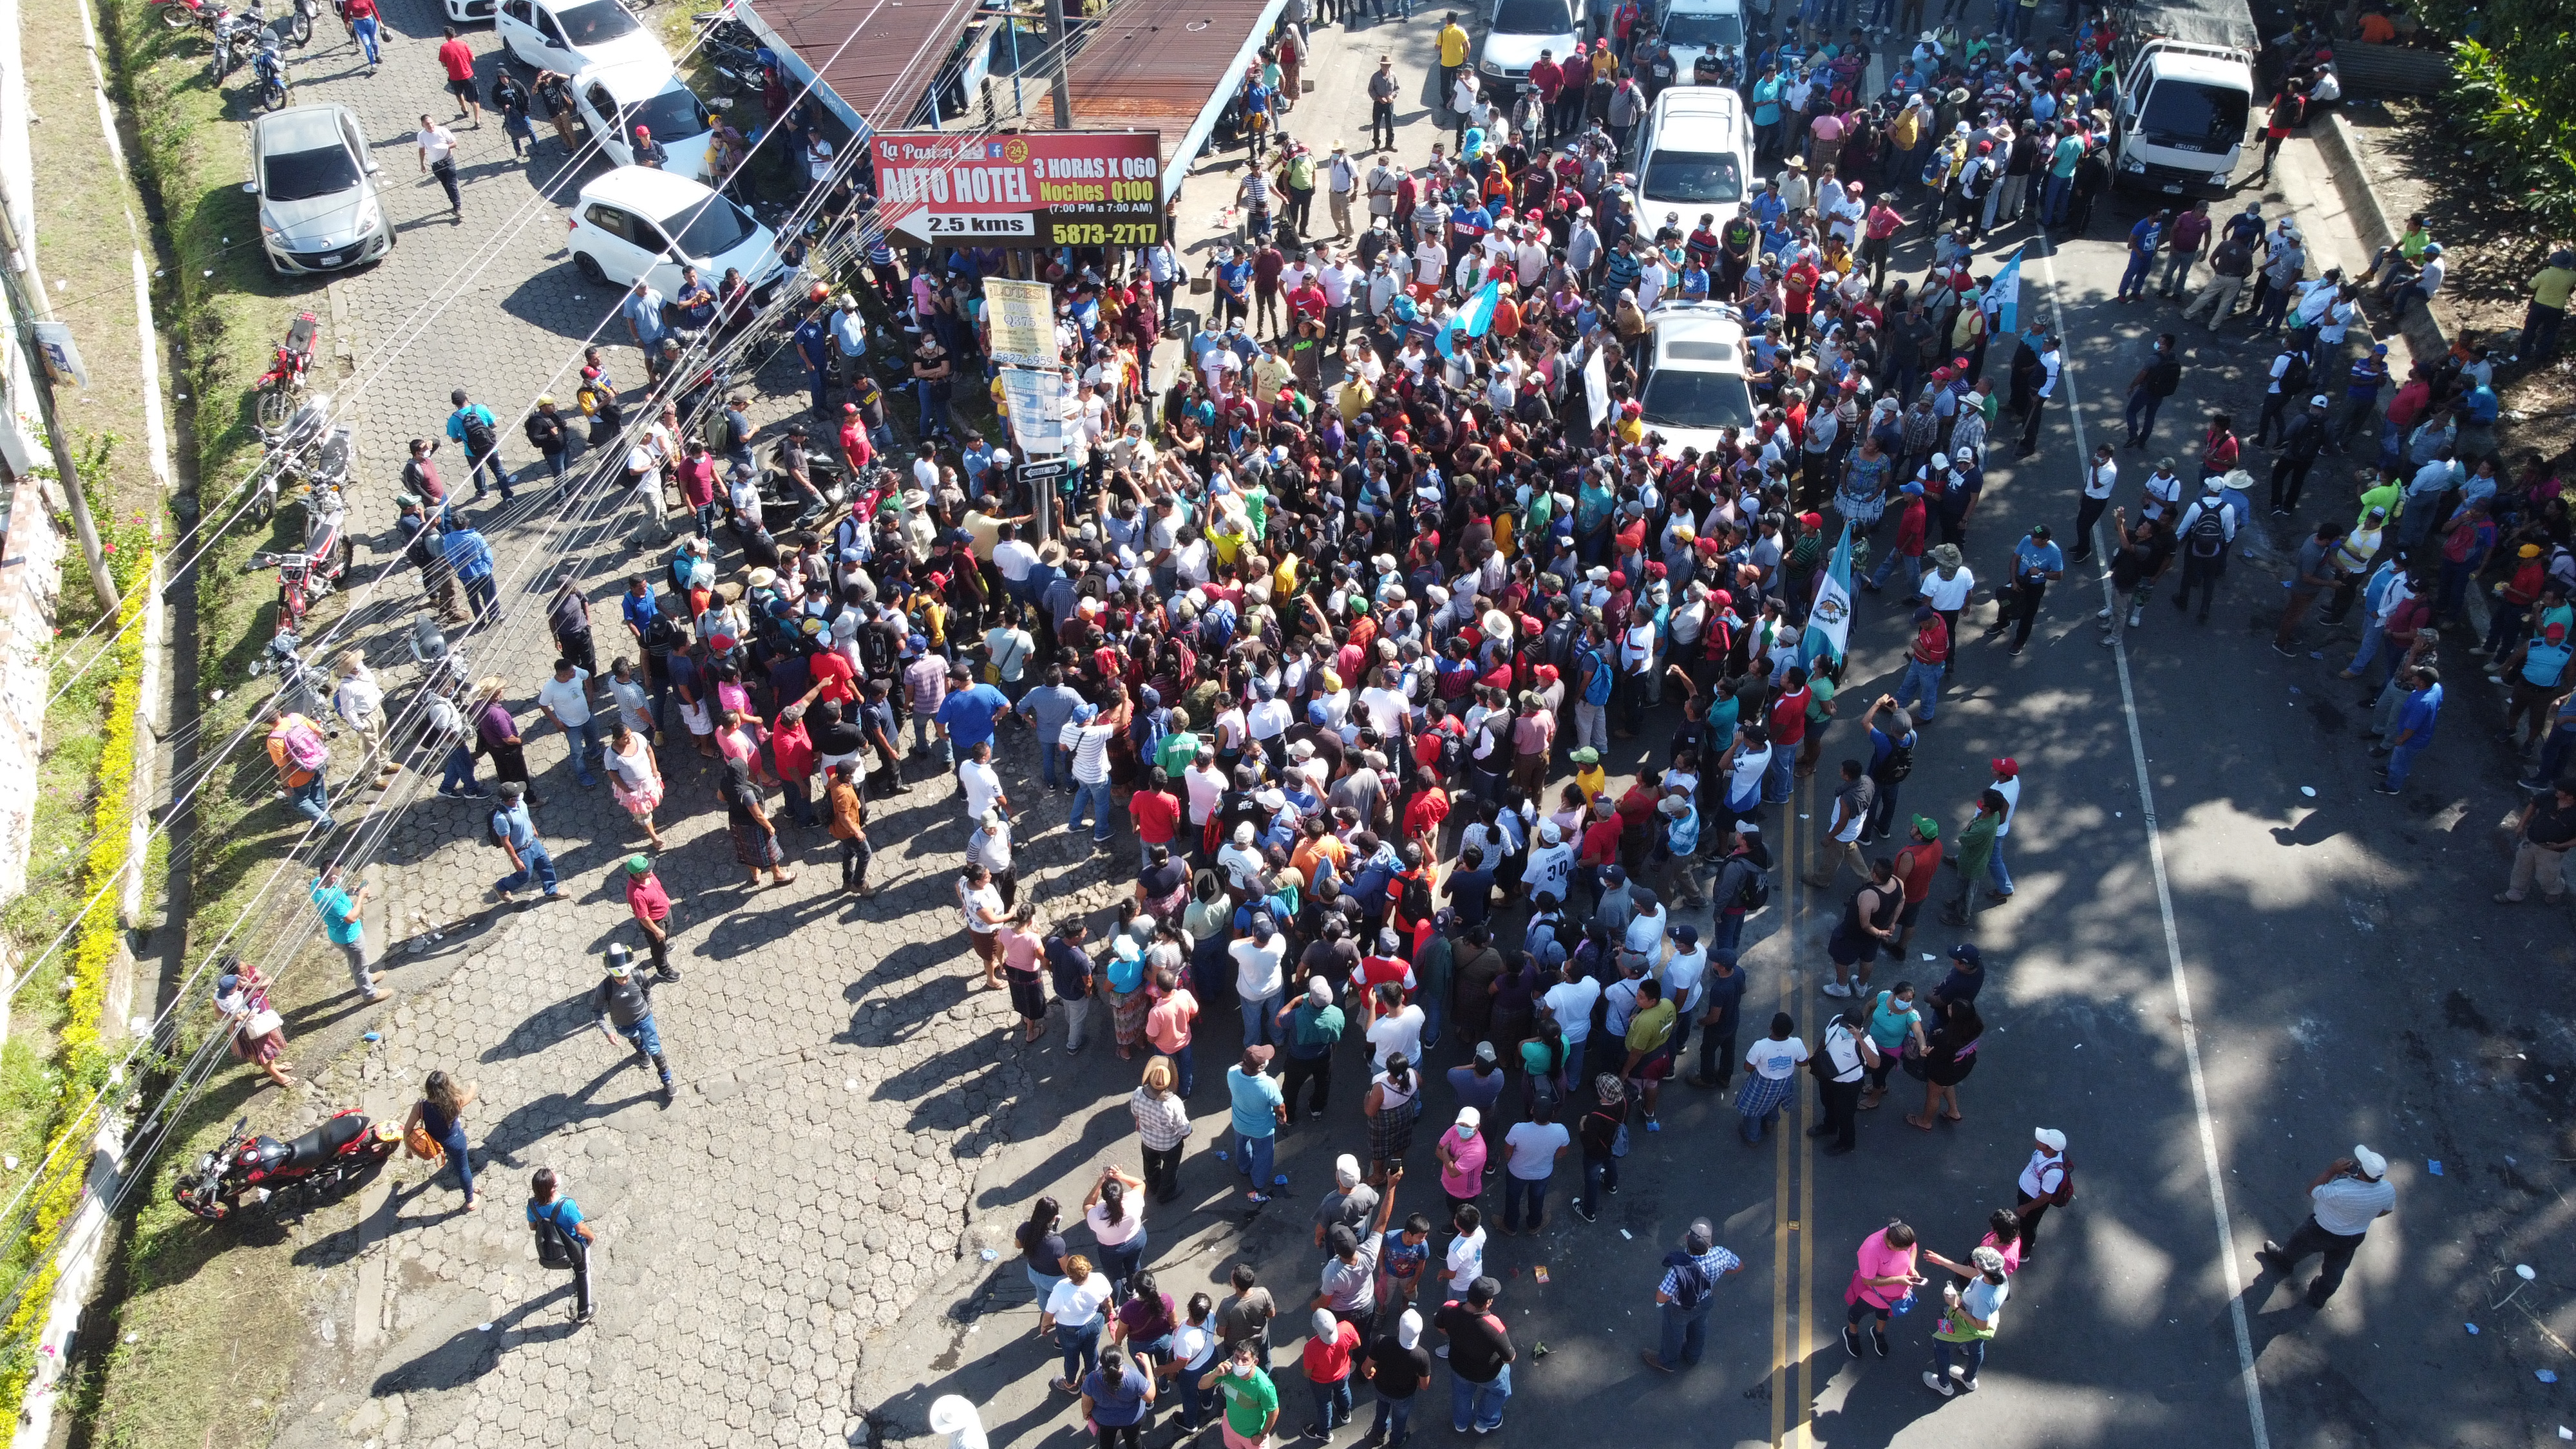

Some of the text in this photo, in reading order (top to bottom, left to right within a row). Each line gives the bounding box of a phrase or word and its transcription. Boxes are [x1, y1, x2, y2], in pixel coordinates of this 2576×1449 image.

[880, 140, 898, 161] La
[1011, 146, 1022, 155] 24
[2175, 143, 2202, 151] ISUZU
[1033, 158, 1156, 180] 3 HORAS X Q60
[882, 167, 1032, 204] AUTO HOTEL
[1040, 181, 1153, 202] Noches Q100
[1050, 204, 1075, 214] (7:00
[1078, 204, 1095, 213] PM
[1106, 204, 1129, 213] 7:00
[1132, 204, 1153, 213] AM)
[927, 218, 1025, 232] 2.5 kms
[1455, 222, 1475, 235] POLO
[1052, 223, 1157, 244] 5873-2717
[996, 352, 1053, 366] 5827-6959
[286, 570, 303, 580] 10
[1547, 859, 1567, 882] 30
